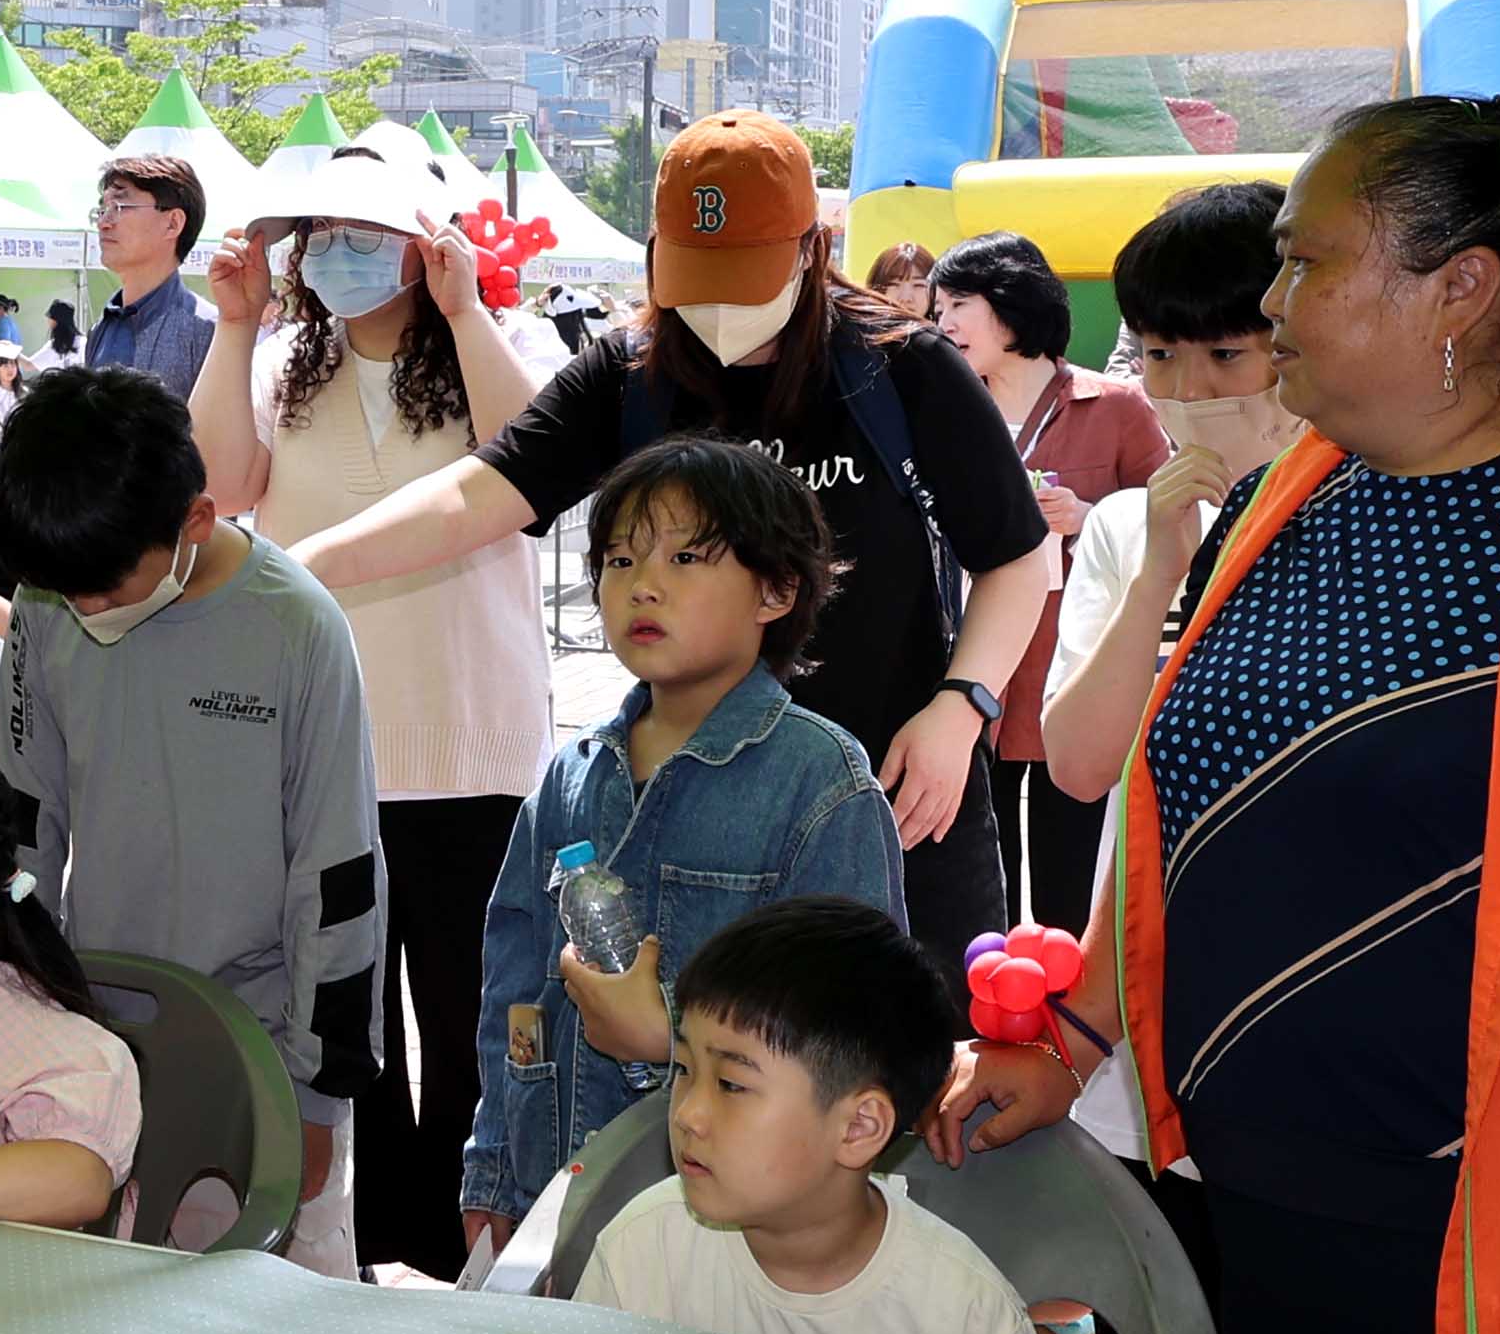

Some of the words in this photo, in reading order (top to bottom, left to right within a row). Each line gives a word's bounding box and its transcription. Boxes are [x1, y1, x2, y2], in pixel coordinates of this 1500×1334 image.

[692, 185, 726, 235] B
[188, 696, 277, 719] NOLIMITS
[211, 690, 242, 703] LEVEL
[245, 694, 261, 705] UP
